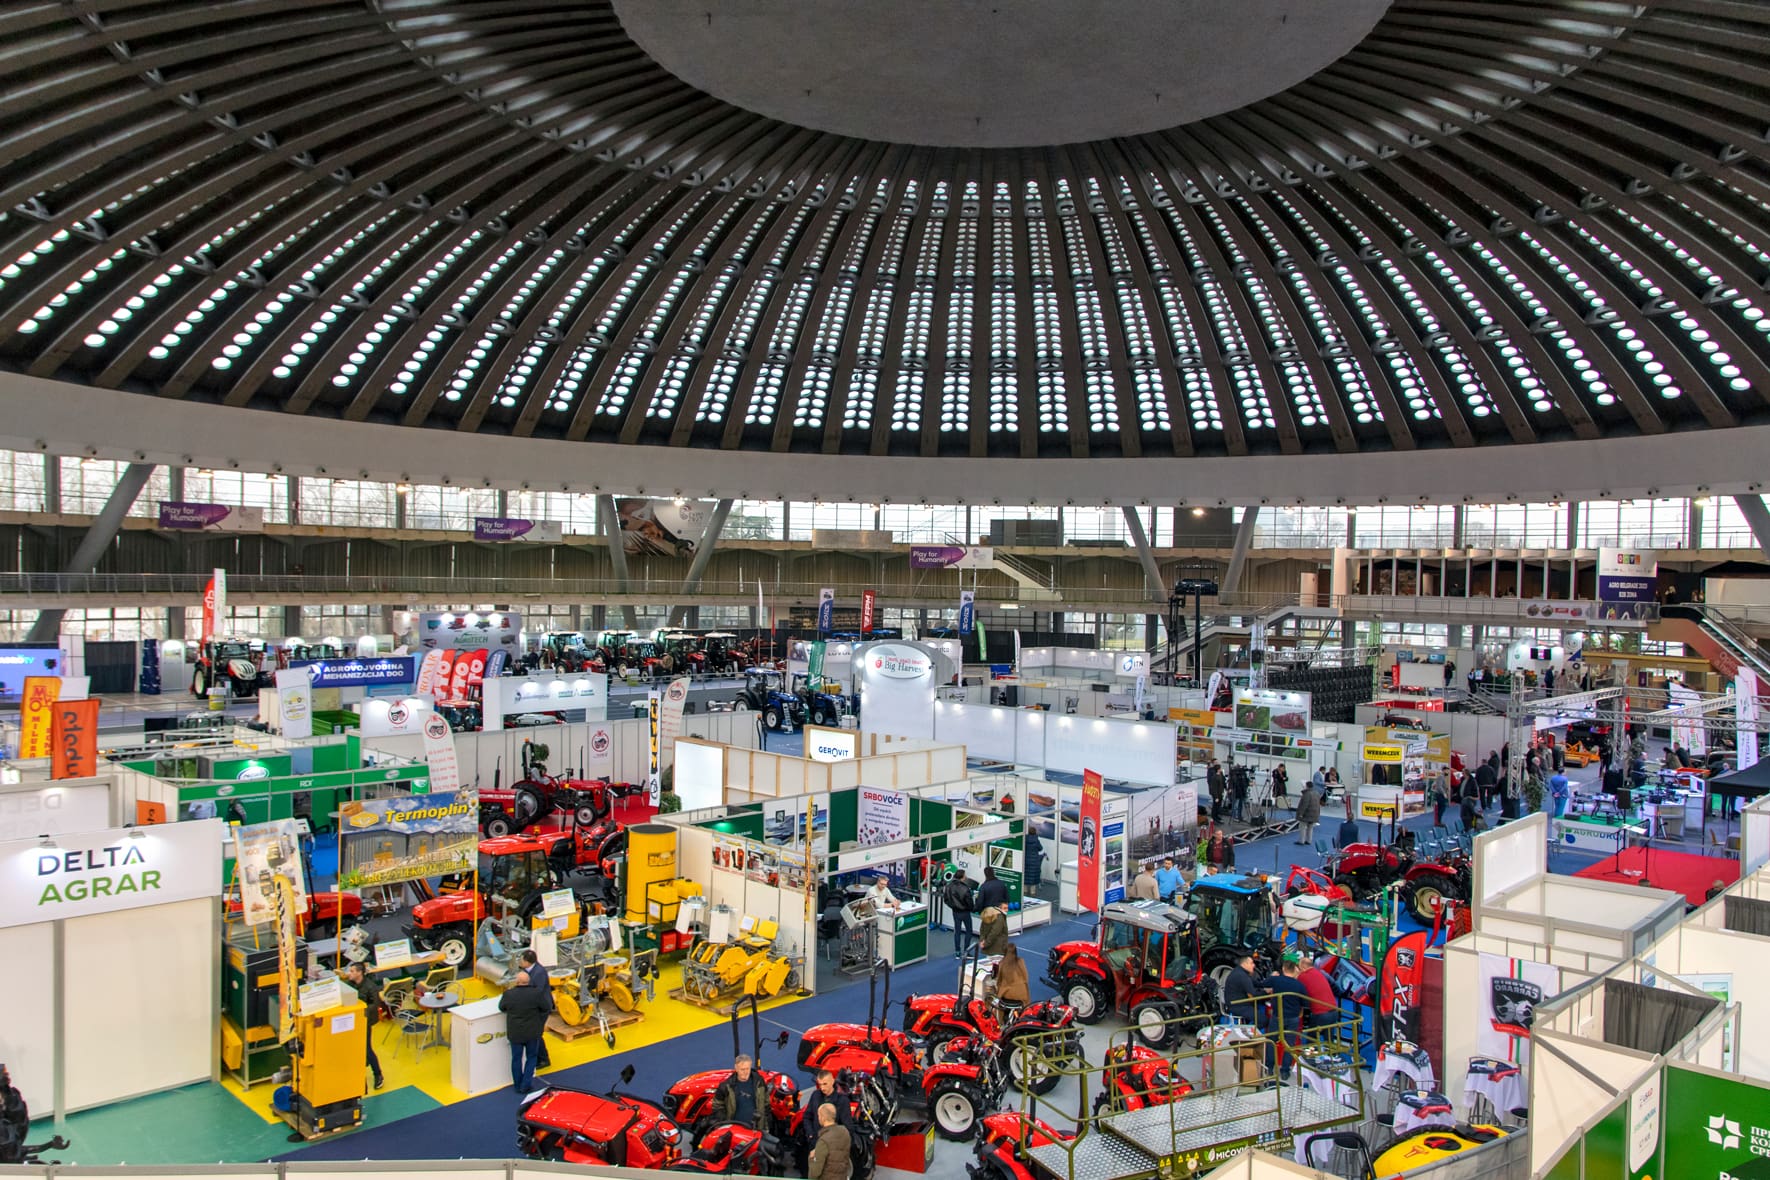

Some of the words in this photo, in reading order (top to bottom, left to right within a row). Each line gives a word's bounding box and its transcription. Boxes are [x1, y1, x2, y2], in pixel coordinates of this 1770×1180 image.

[162, 505, 181, 515] Play
[183, 506, 194, 514] for
[170, 513, 208, 523] Humanity
[477, 520, 494, 529] Play
[483, 527, 516, 536] Humanity
[918, 556, 948, 564] Humanity
[323, 663, 404, 673] AGROVOJVODINA
[884, 661, 896, 673] Big
[323, 671, 385, 680] MEHANIZACIJA
[818, 746, 849, 758] GEROVIT
[864, 791, 903, 806] SRBOVOĆE
[385, 802, 468, 823] Termoplin
[38, 846, 145, 876] DELTA
[38, 870, 161, 906] AGRAR
